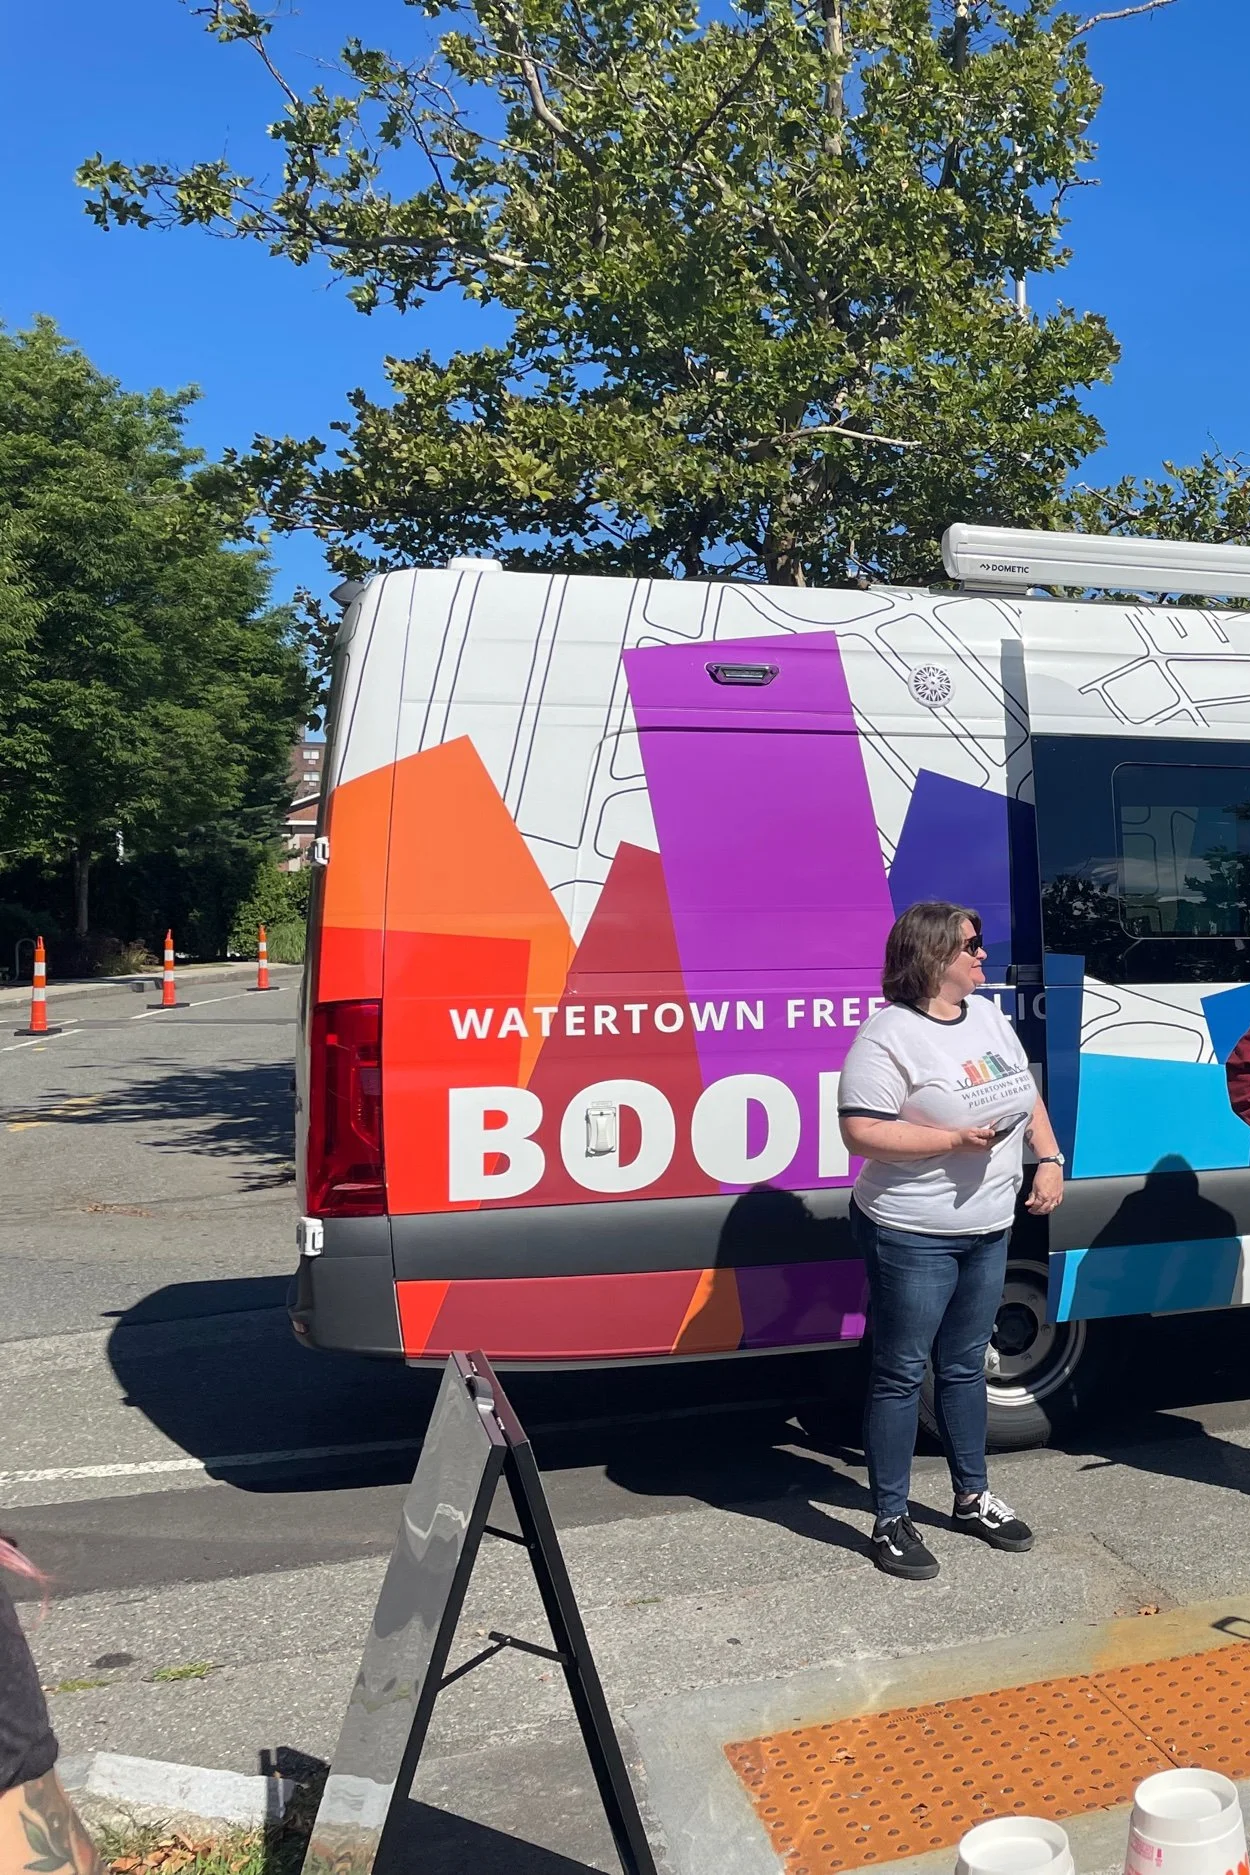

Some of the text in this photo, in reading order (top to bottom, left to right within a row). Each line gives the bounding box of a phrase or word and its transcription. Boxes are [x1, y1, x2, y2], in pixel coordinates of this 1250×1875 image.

[991, 564, 1029, 573] DOMETIC
[449, 1000, 764, 1040] WATERTOWN
[961, 1081, 1013, 1100] WATERTOWN
[969, 1093, 999, 1108] PUBLIC
